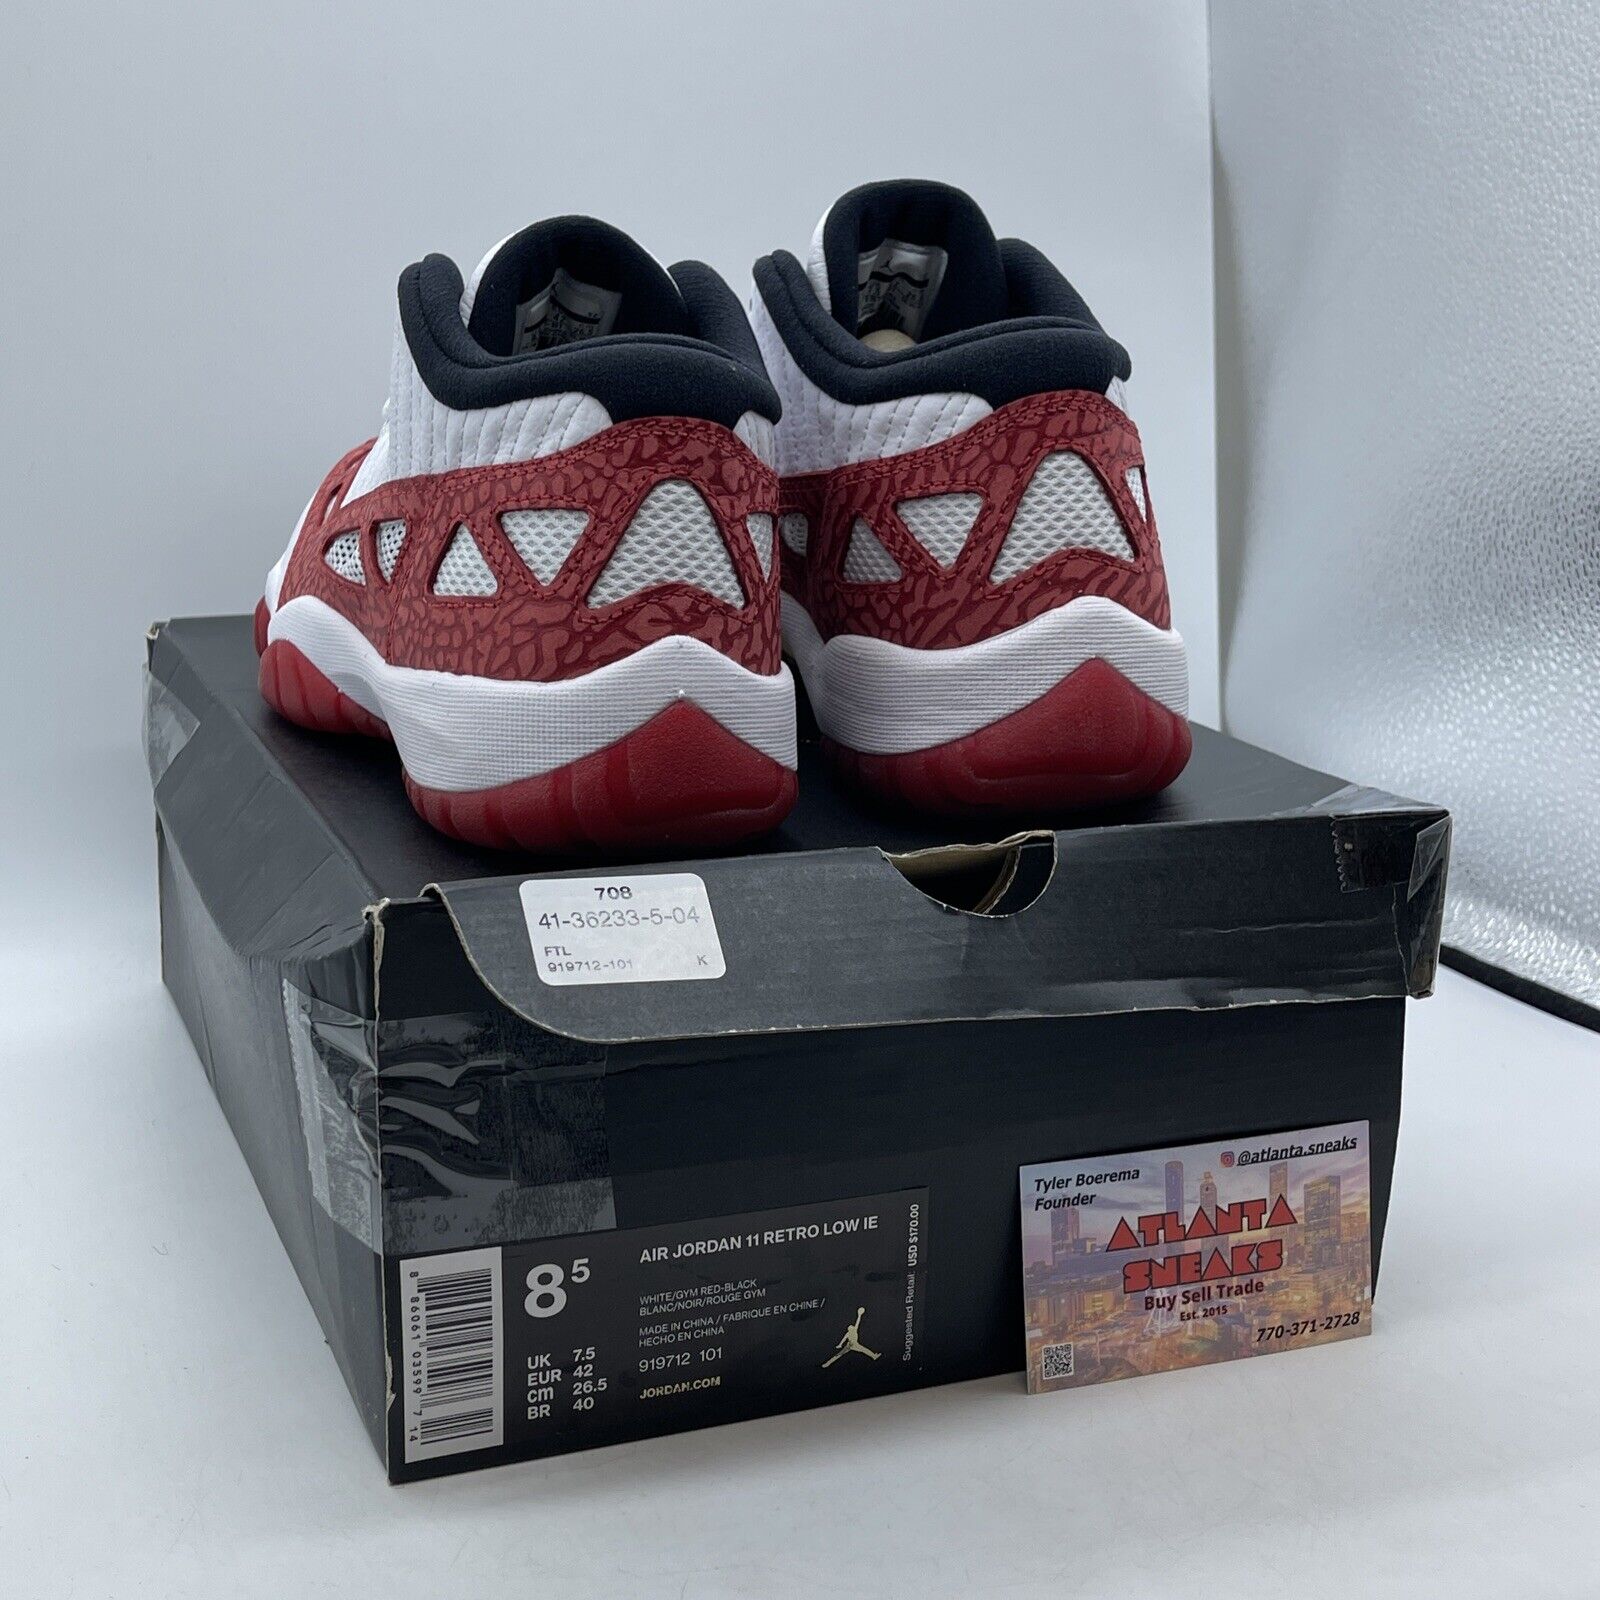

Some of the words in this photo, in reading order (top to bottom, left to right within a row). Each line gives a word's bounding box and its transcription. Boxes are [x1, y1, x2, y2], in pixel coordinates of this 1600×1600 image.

[594, 886, 633, 900] 708
[538, 906, 700, 929] 41-36233-5-04
[544, 946, 572, 956] FTL
[697, 955, 709, 965] K
[547, 959, 633, 972] 919712-101
[1236, 1136, 1358, 1166] @atlanta.sneaks
[1034, 1177, 1073, 1194] Tyler
[1075, 1168, 1140, 1187] Boerema
[1034, 1192, 1097, 1211] Founder
[909, 1203, 920, 1243] $170.00
[1106, 1193, 1299, 1252] ATLANTA
[640, 1247, 669, 1263] AIR
[672, 1235, 743, 1258] JORDAN
[746, 1233, 760, 1247] 11
[763, 1223, 820, 1245] RETRO
[823, 1218, 860, 1236] LOW
[863, 1215, 879, 1230] IE
[908, 1245, 918, 1267] USD
[1123, 1239, 1284, 1294] SNEAKS
[524, 1263, 568, 1318] 8
[639, 1288, 699, 1305] WHITE/GYM
[700, 1279, 758, 1296] RED-BLACK
[639, 1295, 742, 1316] BLANC/NOIR/ROUGE
[743, 1288, 767, 1300] GYM
[1144, 1295, 1177, 1312] Buy
[1181, 1290, 1212, 1305] Sell
[1216, 1279, 1265, 1301] Trade
[410, 1296, 421, 1341] 86061
[639, 1324, 669, 1336] MADE
[671, 1322, 681, 1332] IN
[683, 1316, 713, 1330] CHINA
[723, 1307, 772, 1324] FABRIQUE
[773, 1305, 788, 1316] EN
[790, 1300, 818, 1313] CHINE
[1179, 1311, 1199, 1322] Est.
[1202, 1304, 1229, 1318] 2015
[639, 1334, 676, 1348] HECHO
[678, 1332, 692, 1342] EN
[694, 1325, 725, 1340] CHINA
[903, 1305, 914, 1361] Suggested
[1256, 1311, 1361, 1343] 770-371-2728
[527, 1354, 551, 1369] UK
[573, 1346, 596, 1362] 7.5
[639, 1353, 691, 1372] 919712
[700, 1347, 723, 1362] 101
[412, 1351, 421, 1394] 03599
[527, 1369, 562, 1387] EUR
[573, 1364, 593, 1377] 42
[527, 1387, 554, 1403] cm
[573, 1378, 608, 1395] 26.5
[639, 1376, 721, 1399] JORDAN.COM
[527, 1405, 551, 1420] BR
[573, 1396, 595, 1411] 40
